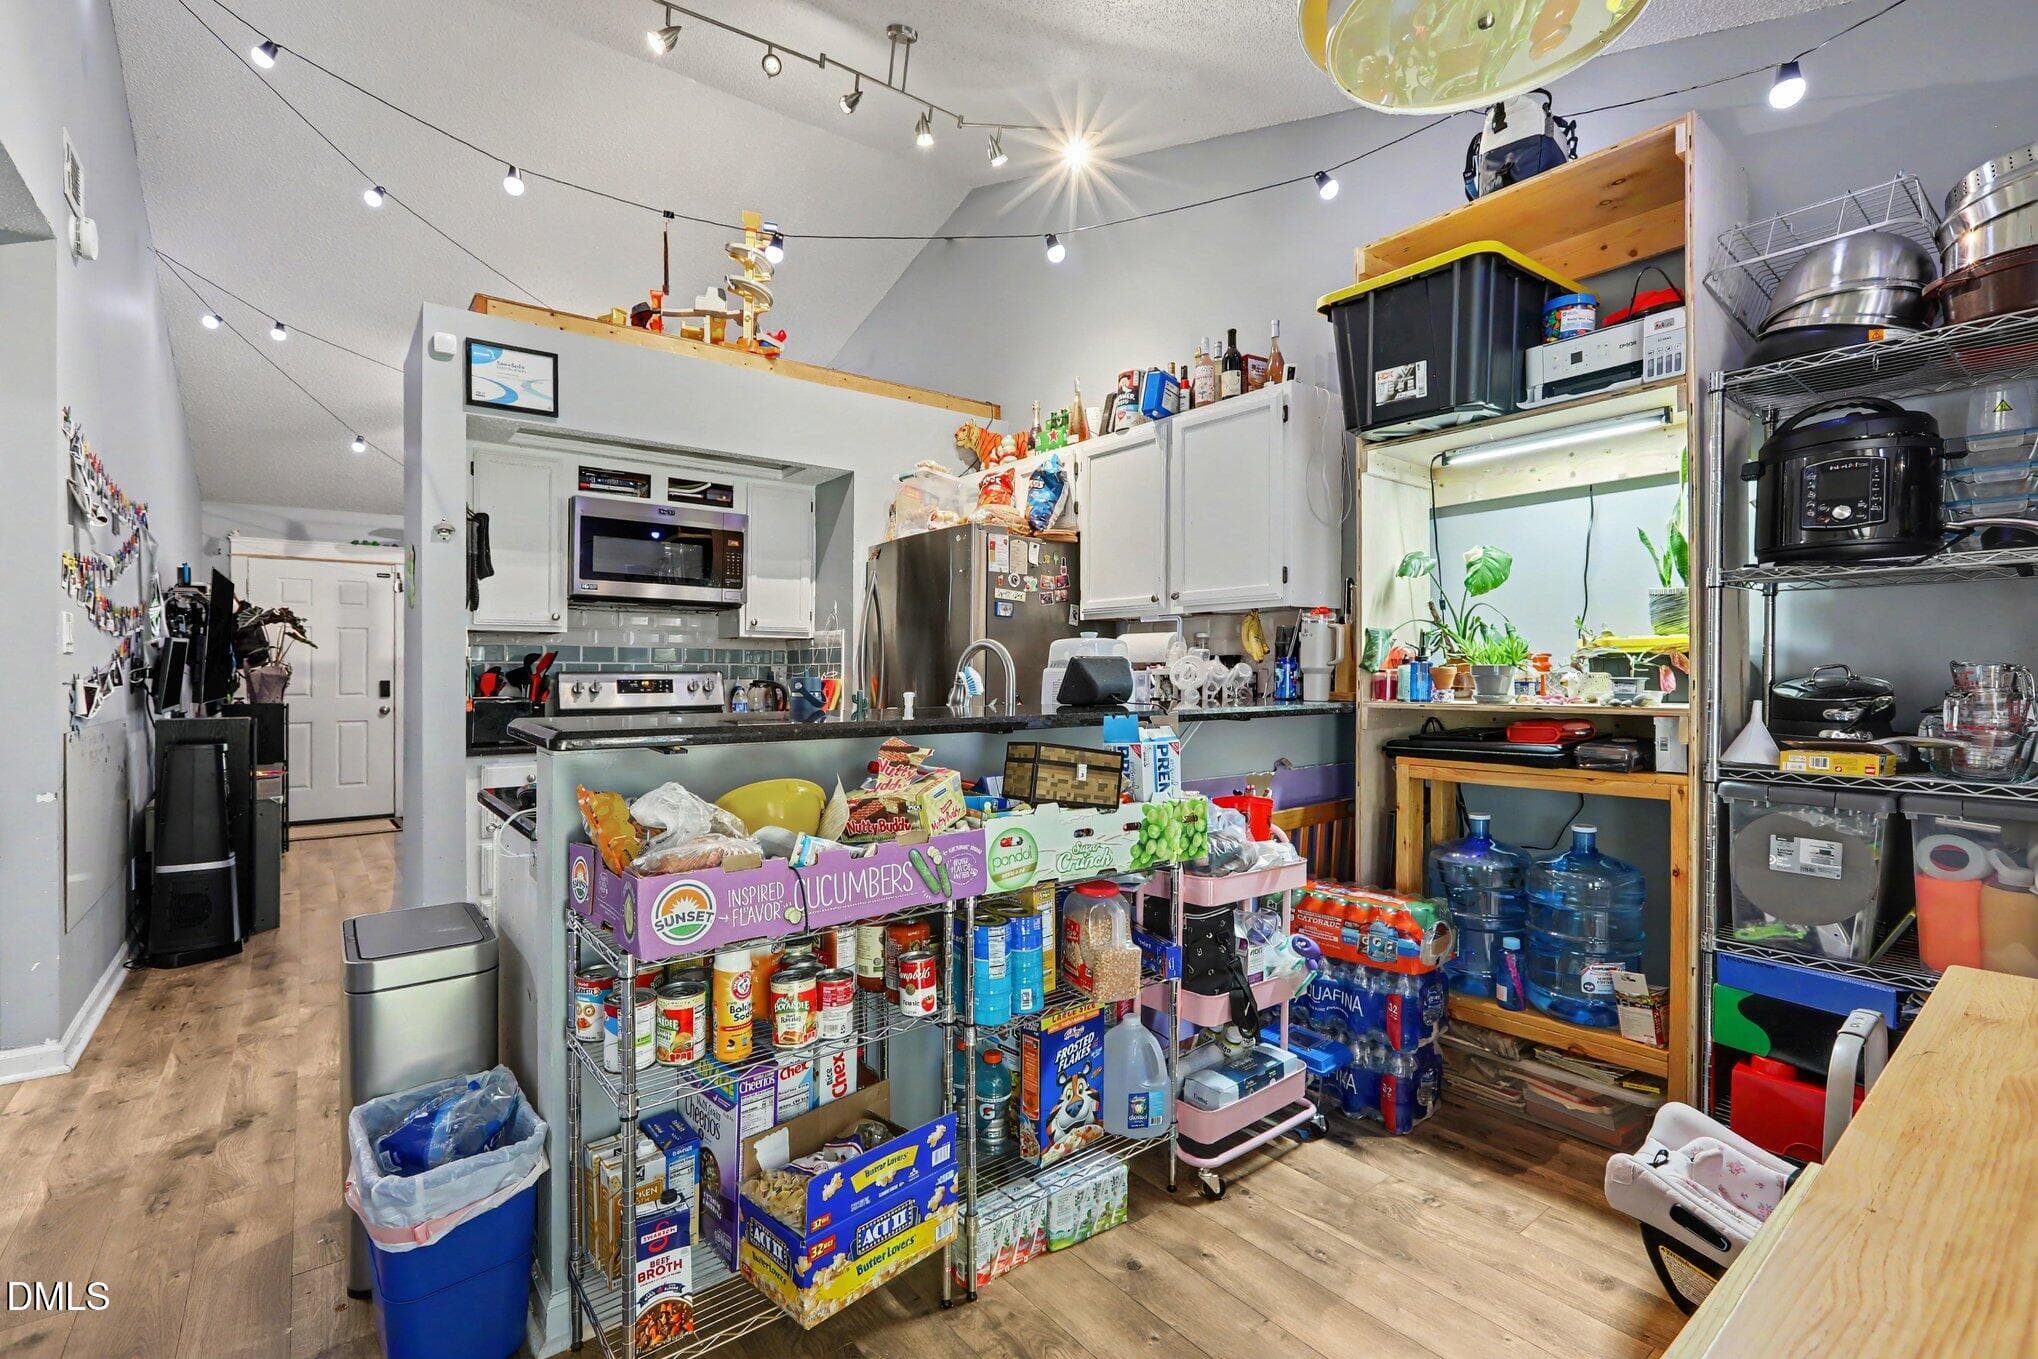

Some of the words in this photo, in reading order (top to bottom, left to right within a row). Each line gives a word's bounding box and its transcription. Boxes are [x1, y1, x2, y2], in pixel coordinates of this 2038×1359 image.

[846, 819, 880, 835] Nutty
[992, 845, 1033, 872] pandol
[1056, 846, 1113, 873] Crunch
[727, 881, 785, 908] INSPIRED
[794, 861, 914, 912] CUCUMBERS
[654, 911, 714, 932] SUNSET
[732, 901, 783, 928] FLAVOR
[1055, 1032, 1095, 1063] FROSTED
[1057, 1043, 1091, 1072] FLAKES
[779, 1061, 808, 1081] Chex
[832, 1051, 848, 1098] Chex
[739, 1077, 775, 1094] Cheerios
[862, 1216, 891, 1246] ACT
[649, 1255, 671, 1268] BEEF
[856, 1252, 887, 1276] Butter
[886, 1234, 916, 1258] Lovers
[637, 1258, 683, 1284] BROTH
